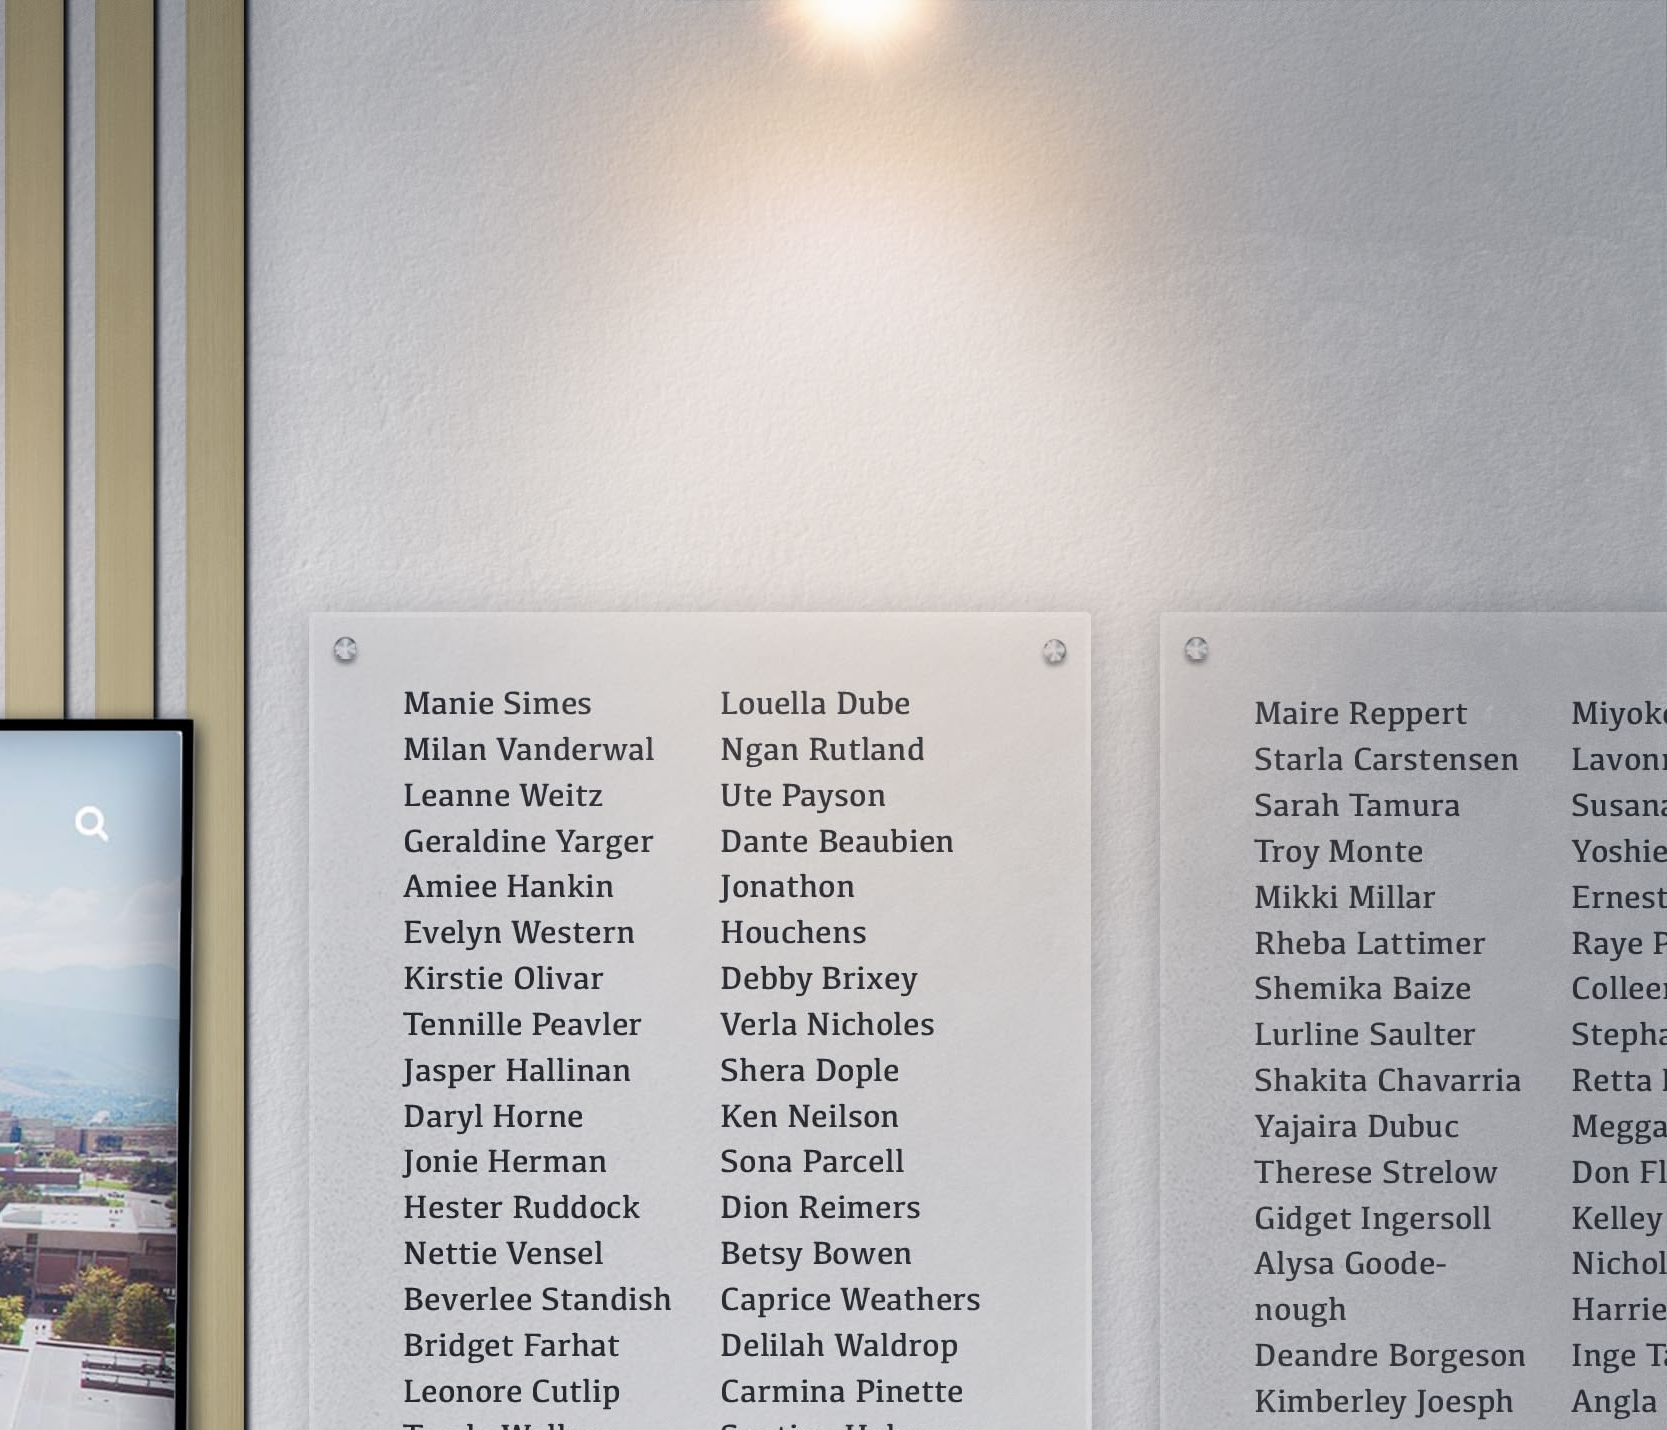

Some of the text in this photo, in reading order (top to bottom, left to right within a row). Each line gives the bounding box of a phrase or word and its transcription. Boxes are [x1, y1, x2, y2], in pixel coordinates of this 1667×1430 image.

[720, 689, 910, 716] Louella Dube
[1254, 700, 1468, 733] Maire Reppert
[1571, 700, 1667, 732] Miyok
[403, 735, 655, 762] Milan Vanderwal
[720, 782, 886, 815] Ute Payson
[1254, 791, 1461, 817] Sarah Tamura
[404, 827, 655, 861] Geraldine Yarger
[1571, 838, 1667, 864] Yoshie
[718, 872, 855, 904] Jonathon
[1254, 883, 1436, 909] Mikki Millar
[403, 918, 635, 951] Evelyn Western
[1571, 930, 1643, 962] Raye
[720, 965, 919, 998] Debby Brixey
[1254, 975, 1471, 1001] Shemika Baize
[1572, 975, 1667, 1001] Collee
[402, 1010, 643, 1037] Tennille Peavler
[720, 1056, 899, 1090] Shera Dople
[1254, 1067, 1522, 1093] Shakita Chavarria
[403, 1102, 583, 1136] Daryl Horne
[720, 1147, 905, 1174] Sona Parcell
[1253, 1159, 1499, 1185] Therese Strelow
[1571, 1159, 1630, 1185] Don
[403, 1193, 641, 1220] Hester Ruddock
[1571, 1205, 1664, 1237] Kelley
[720, 1240, 912, 1273] Betsy Bowen
[1253, 1250, 1447, 1282] Alysa Goode-
[403, 1285, 672, 1312] Beverlee Standish
[1571, 1296, 1667, 1321] Harrie
[720, 1331, 958, 1365] Delilah Waldrop
[1254, 1342, 1526, 1374] Deandre Borgeson
[403, 1377, 620, 1411] Leonore Cutlip
[1570, 1388, 1658, 1420] Angla
